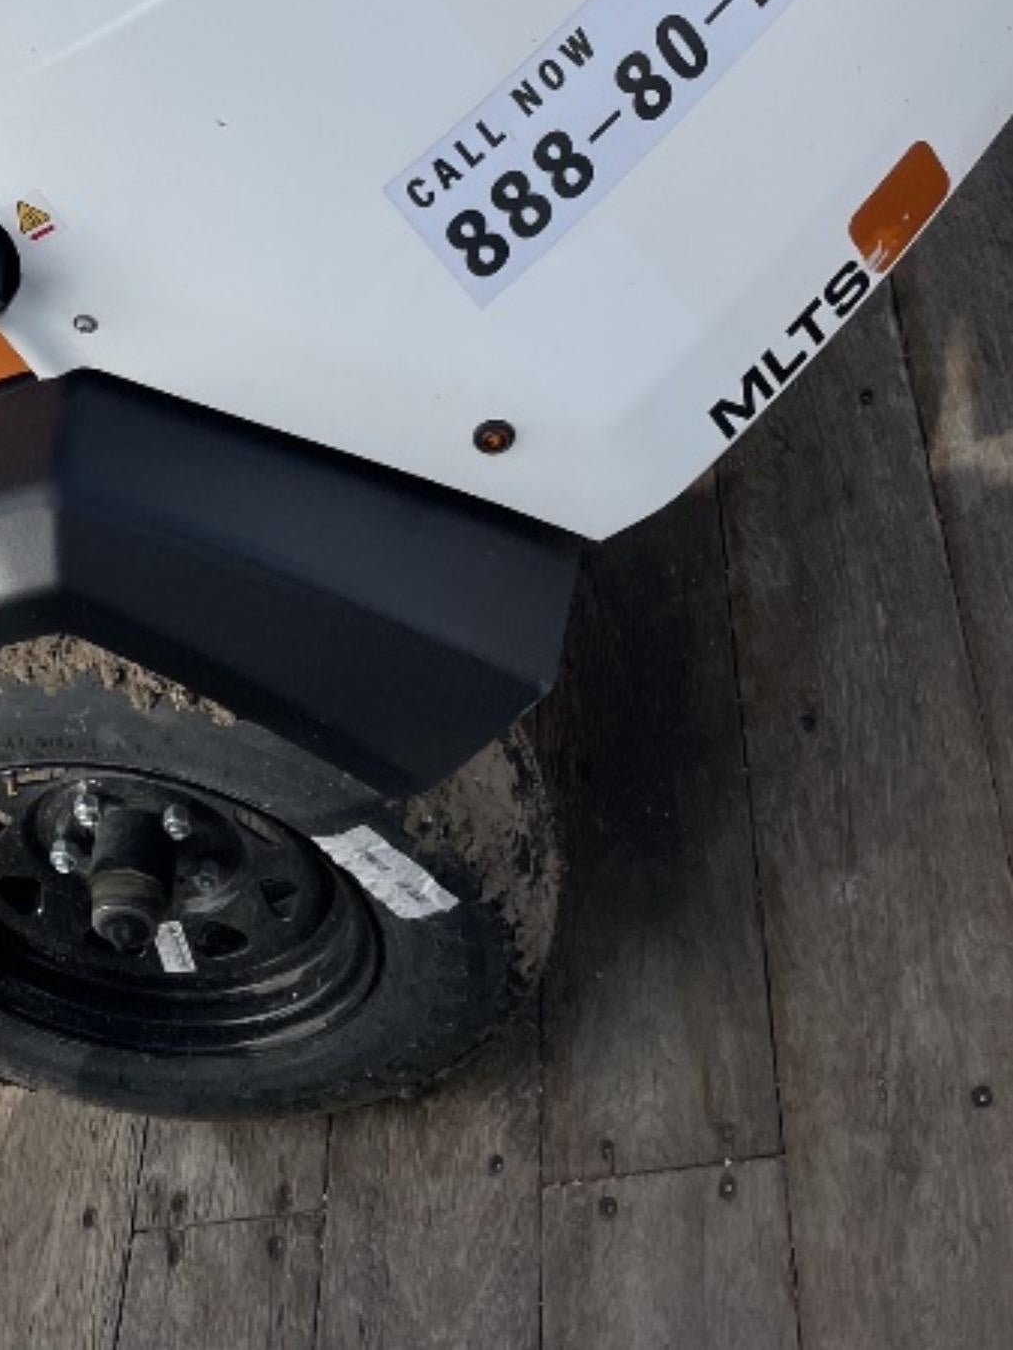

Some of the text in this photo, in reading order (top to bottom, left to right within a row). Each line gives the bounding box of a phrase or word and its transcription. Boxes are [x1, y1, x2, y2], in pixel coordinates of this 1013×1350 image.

[405, 26, 595, 209] CALL NOW
[707, 259, 871, 440] MLTS
